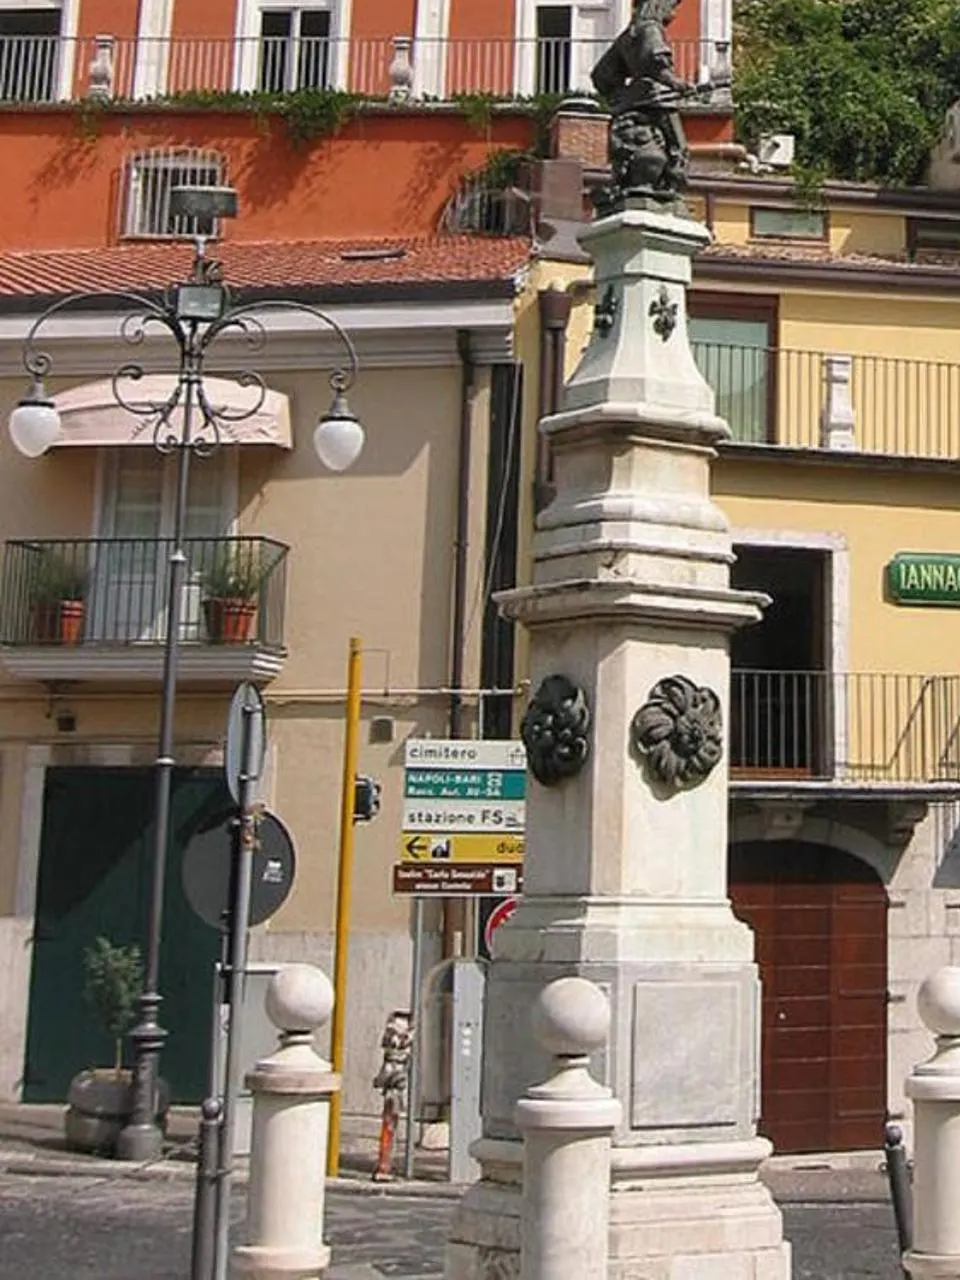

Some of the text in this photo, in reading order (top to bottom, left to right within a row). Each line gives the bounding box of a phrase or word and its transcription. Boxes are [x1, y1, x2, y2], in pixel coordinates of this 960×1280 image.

[408, 744, 478, 759] cimitero
[408, 808, 503, 825] stazione FS
